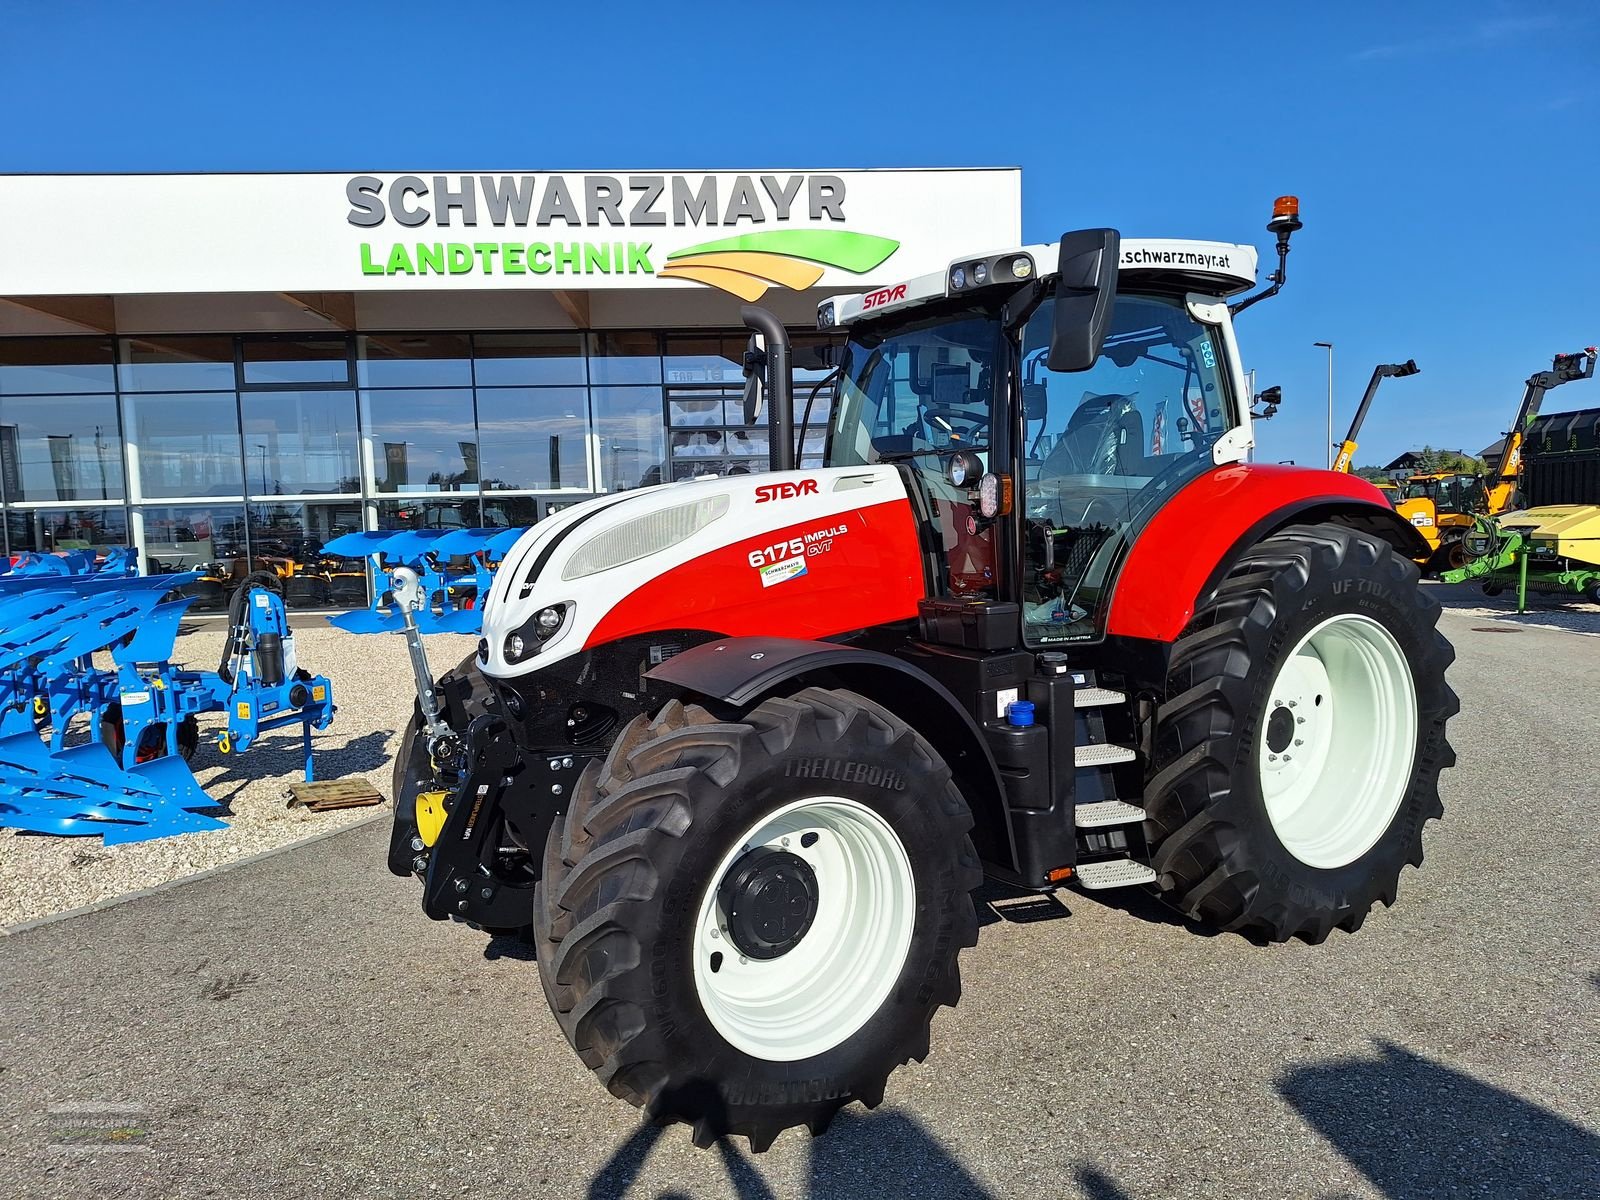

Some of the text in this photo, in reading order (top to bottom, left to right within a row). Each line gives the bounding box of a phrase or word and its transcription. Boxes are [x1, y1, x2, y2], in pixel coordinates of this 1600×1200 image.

[346, 174, 847, 228] SCHWARZMAYR
[361, 241, 655, 275] LANDTECHNIK
[863, 284, 907, 310] STEYR
[755, 479, 820, 504] STEYR
[748, 525, 848, 568] 6175 IMPULS
[807, 539, 833, 557] CVT
